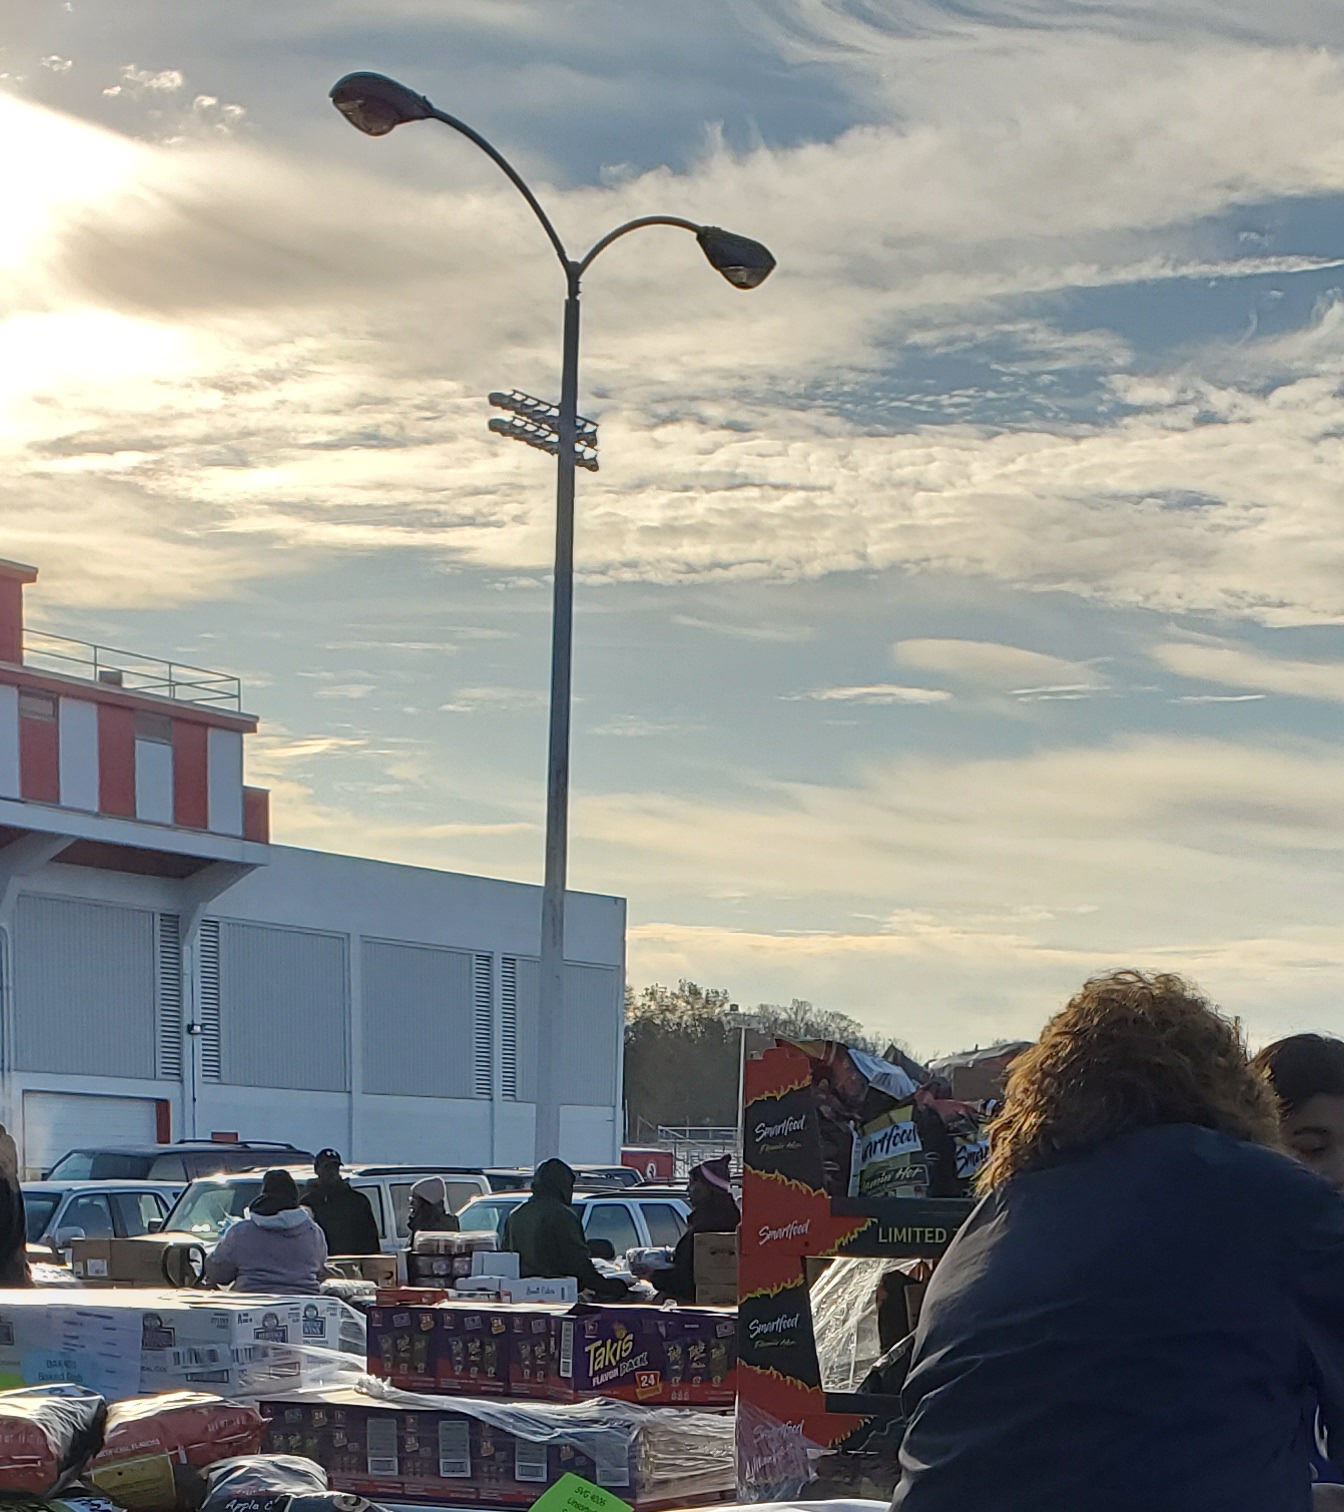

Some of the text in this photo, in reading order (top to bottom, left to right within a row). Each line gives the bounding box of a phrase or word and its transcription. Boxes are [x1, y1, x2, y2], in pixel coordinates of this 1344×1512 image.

[862, 1124, 917, 1162] artfood
[878, 1227, 947, 1243] LIMITED
[748, 1313, 800, 1339] Smartfood
[585, 1334, 634, 1377] Takis
[640, 1375, 656, 1388] 24
